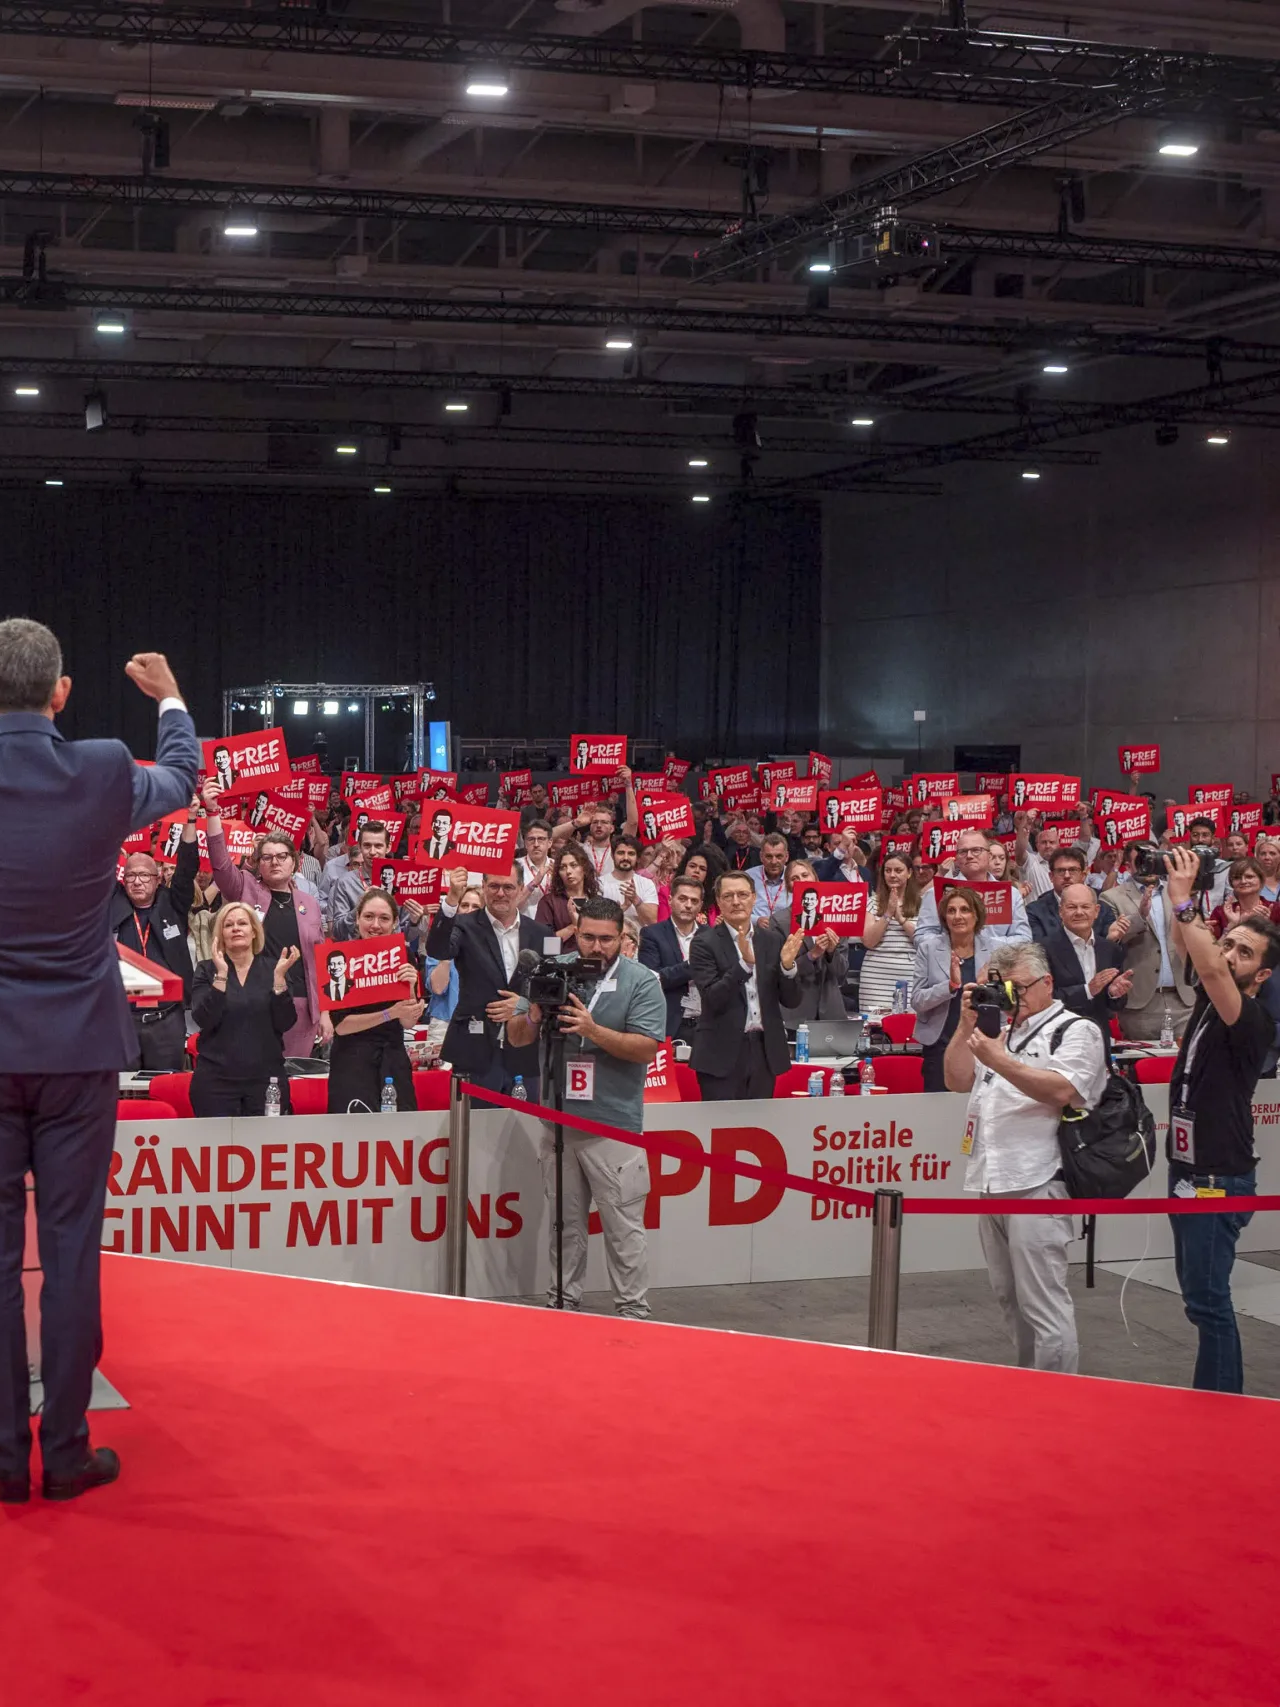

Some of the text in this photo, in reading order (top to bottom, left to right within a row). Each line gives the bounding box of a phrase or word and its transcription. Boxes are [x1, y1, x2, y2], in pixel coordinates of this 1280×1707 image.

[233, 739, 280, 770] FREE
[590, 742, 622, 758] FREE
[1132, 750, 1156, 761] FREE
[297, 758, 317, 770] FREE
[592, 757, 619, 765] IMAMOGLU
[240, 762, 280, 778] IMAMOGLU
[674, 764, 688, 774] FREE
[770, 766, 794, 780] FREE
[510, 774, 528, 784] FREE
[642, 777, 664, 788] FREE
[724, 770, 748, 786] FREE
[986, 778, 1004, 786] FREE
[274, 778, 306, 793] REE
[308, 783, 328, 794] REE
[354, 780, 379, 790] FREE
[402, 780, 416, 790] FRE
[558, 784, 578, 796] FREE
[928, 779, 956, 792] FREE
[1026, 781, 1060, 795] FREE
[1062, 783, 1078, 794] EE
[786, 786, 814, 798] FREE
[1028, 794, 1056, 802] IMAMOGLU
[1204, 789, 1231, 802] FREE
[364, 790, 390, 808] FREE
[840, 796, 878, 816] FREE
[960, 800, 988, 813] FREE
[265, 804, 306, 831] FREE
[656, 804, 688, 826] FREE
[844, 814, 874, 822] IMAMOGLU
[1240, 808, 1261, 824] FREE
[662, 820, 688, 832] IMAMOGLU
[1118, 814, 1147, 834] FREE
[452, 820, 512, 844] FREE
[1058, 826, 1080, 838] FREE
[1122, 828, 1146, 840] IMAMOGLU
[456, 844, 503, 858] IMAMOGLU
[896, 842, 912, 852] FRE
[396, 868, 438, 886] FREE
[400, 886, 434, 896] IMAMOGLU
[819, 892, 864, 914] FREE
[823, 913, 858, 924] IMAMOGLU
[350, 946, 401, 979] FREE
[572, 1070, 588, 1091] B
[644, 1075, 667, 1088] OGLU
[812, 1120, 914, 1152] Soziale
[1176, 1127, 1188, 1152] B
[105, 1135, 451, 1196] RÄNDERUNG
[812, 1153, 951, 1186] Politik für
[588, 1126, 788, 1235] PD
[101, 1192, 524, 1254] GINNT MIT UNS
